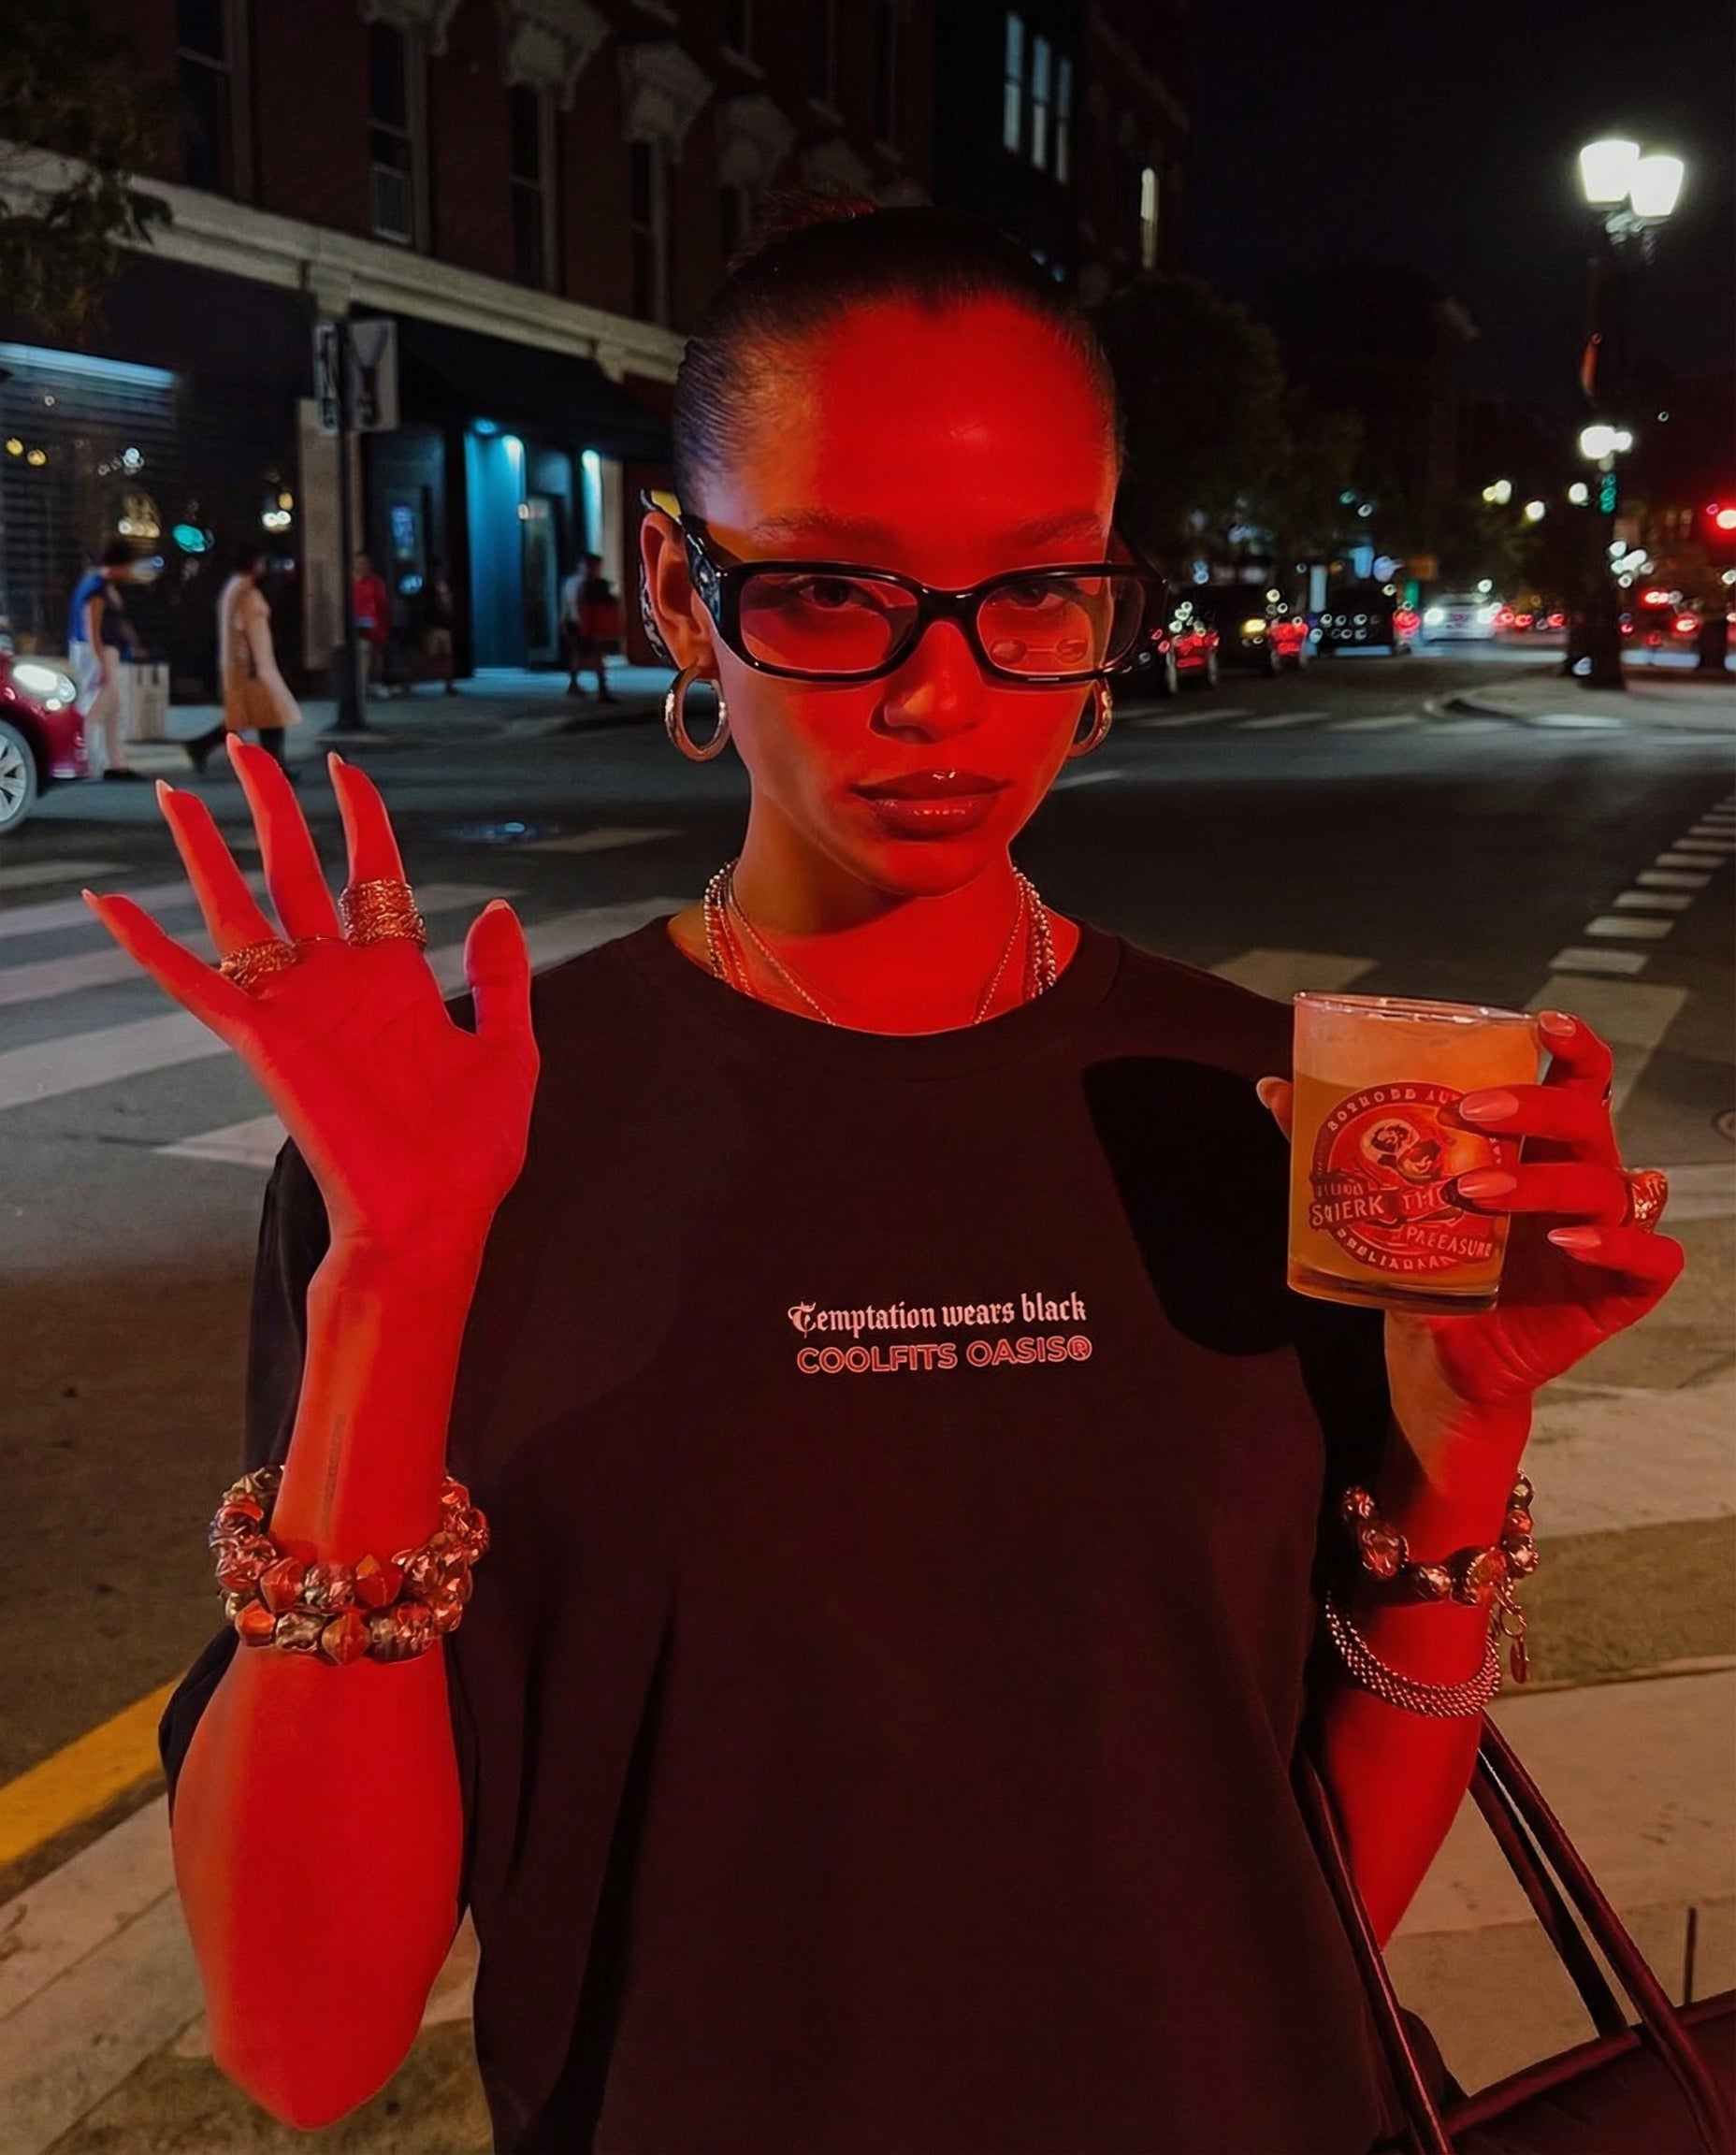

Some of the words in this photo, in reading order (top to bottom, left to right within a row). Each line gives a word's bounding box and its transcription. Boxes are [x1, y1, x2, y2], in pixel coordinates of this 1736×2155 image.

[788, 1301, 937, 1338] Temptation
[942, 1301, 1015, 1326] wears
[1021, 1291, 1087, 1323] black
[797, 1343, 958, 1374] COOLFITS
